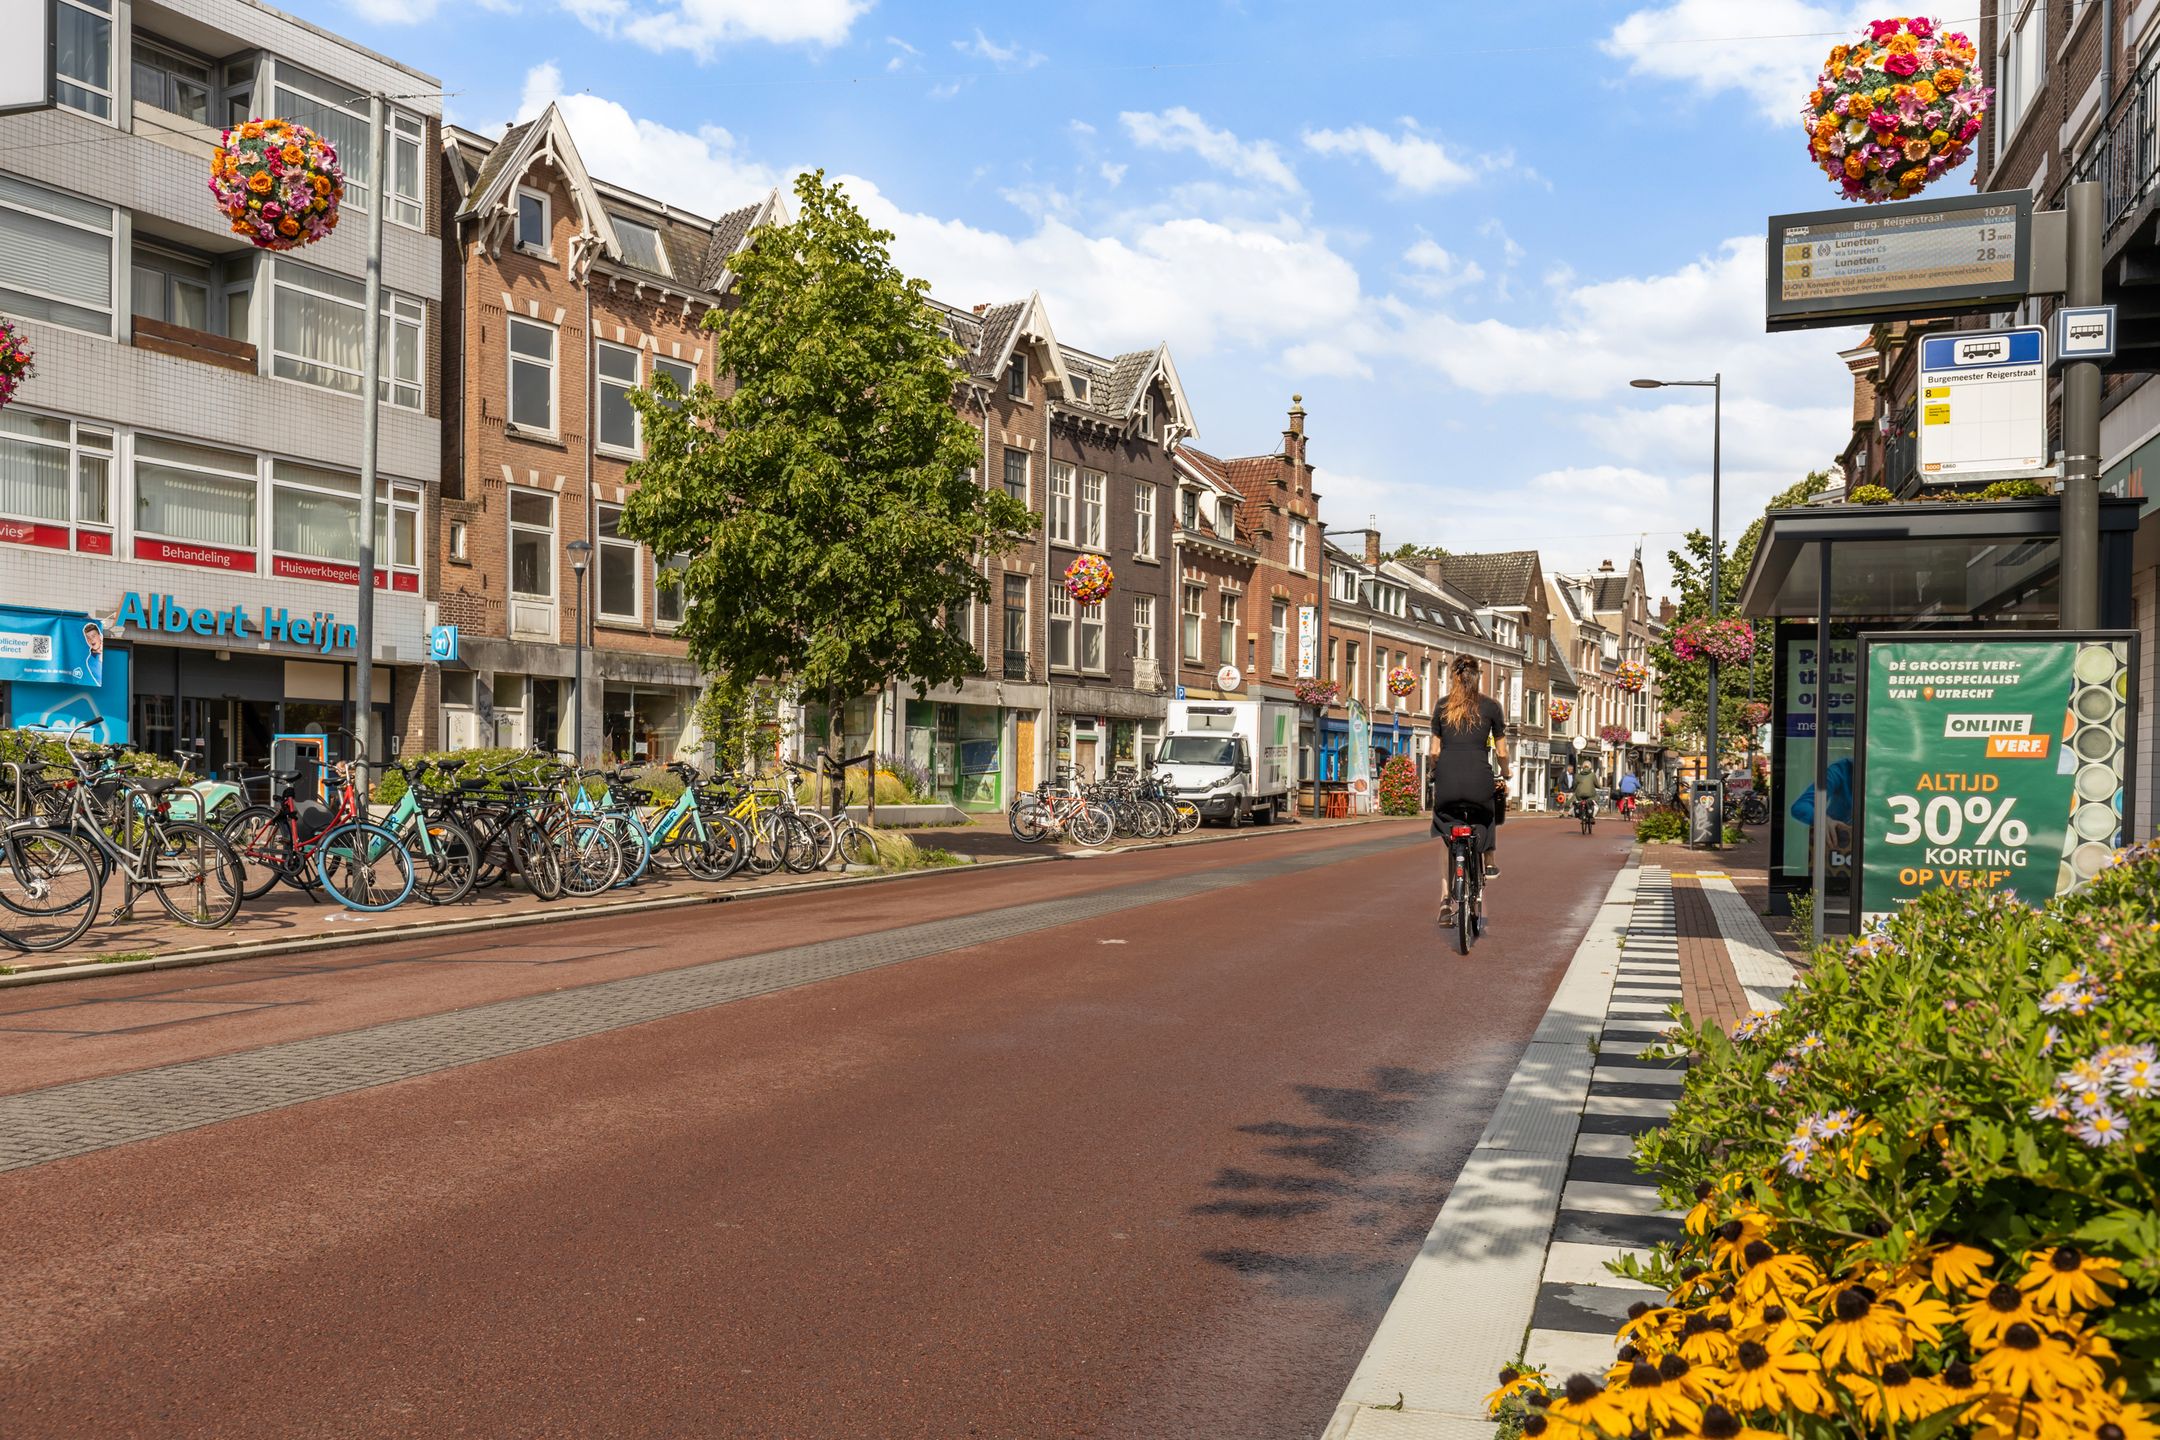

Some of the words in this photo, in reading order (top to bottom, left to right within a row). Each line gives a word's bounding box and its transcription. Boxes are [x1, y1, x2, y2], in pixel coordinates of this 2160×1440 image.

[1854, 220, 1880, 230] Burg.
[1883, 214, 1944, 228] Reigerstraat
[1835, 231, 1866, 239] Richting
[1978, 228, 1996, 241] 13
[1835, 238, 1879, 249] Lunetten
[1802, 247, 1811, 259] 8
[1847, 247, 1875, 256] Utrecht
[1877, 245, 1887, 253] CS
[1977, 247, 1996, 261] 28
[1835, 257, 1879, 267] Lunetten
[1801, 265, 1811, 278] 8
[1847, 266, 1875, 274] Utrecht
[1927, 373, 1985, 384] Burgemeester
[1986, 369, 2037, 380] Reigerstraat
[1925, 389, 1932, 398] 8
[0, 525, 24, 538] vies
[162, 545, 231, 567] Behandeling
[280, 561, 380, 586] Huiswerkbegeleig
[115, 591, 249, 638] Albert
[262, 606, 358, 654] Heijn
[1, 645, 21, 653] direct
[1888, 659, 1906, 671] DÉ
[1909, 661, 1979, 671] GROOTSTE
[1982, 661, 2022, 671] VERF-
[1888, 675, 2020, 685] BEHANGSPECIALIST
[1888, 689, 1918, 699] VAN
[1935, 689, 1994, 699] UTRECHT
[1951, 719, 2023, 732] ONLINE
[1916, 773, 2000, 792] ALTIJD
[655, 811, 678, 836] TIER
[1884, 795, 2029, 847] 30%
[1925, 848, 2027, 867] KORTING
[1899, 868, 1934, 886] OP
